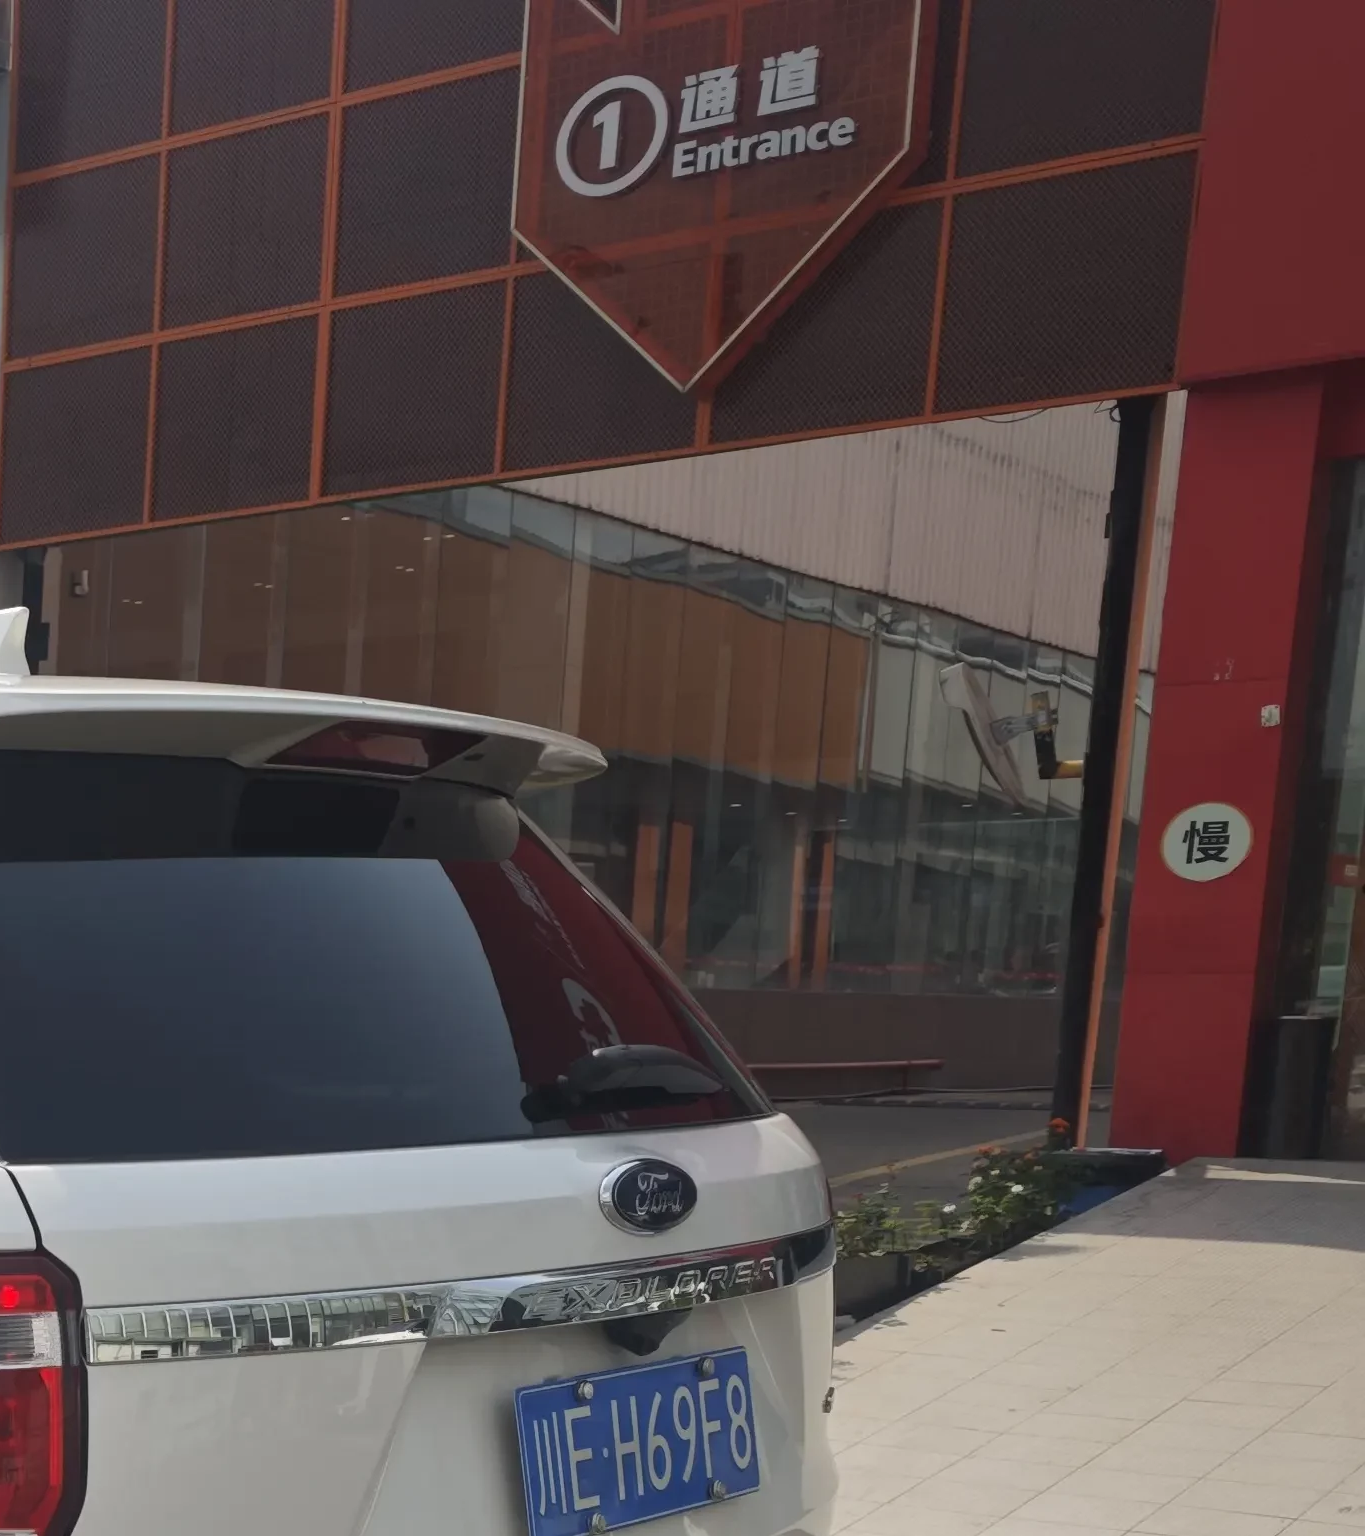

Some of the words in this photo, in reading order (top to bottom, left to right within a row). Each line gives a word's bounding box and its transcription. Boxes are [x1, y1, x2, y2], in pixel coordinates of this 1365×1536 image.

[678, 45, 821, 135] 通道
[672, 116, 855, 179] Entrance
[1182, 820, 1230, 865] 慢
[634, 1171, 684, 1216] Ford
[522, 1256, 777, 1321] EXPLORER
